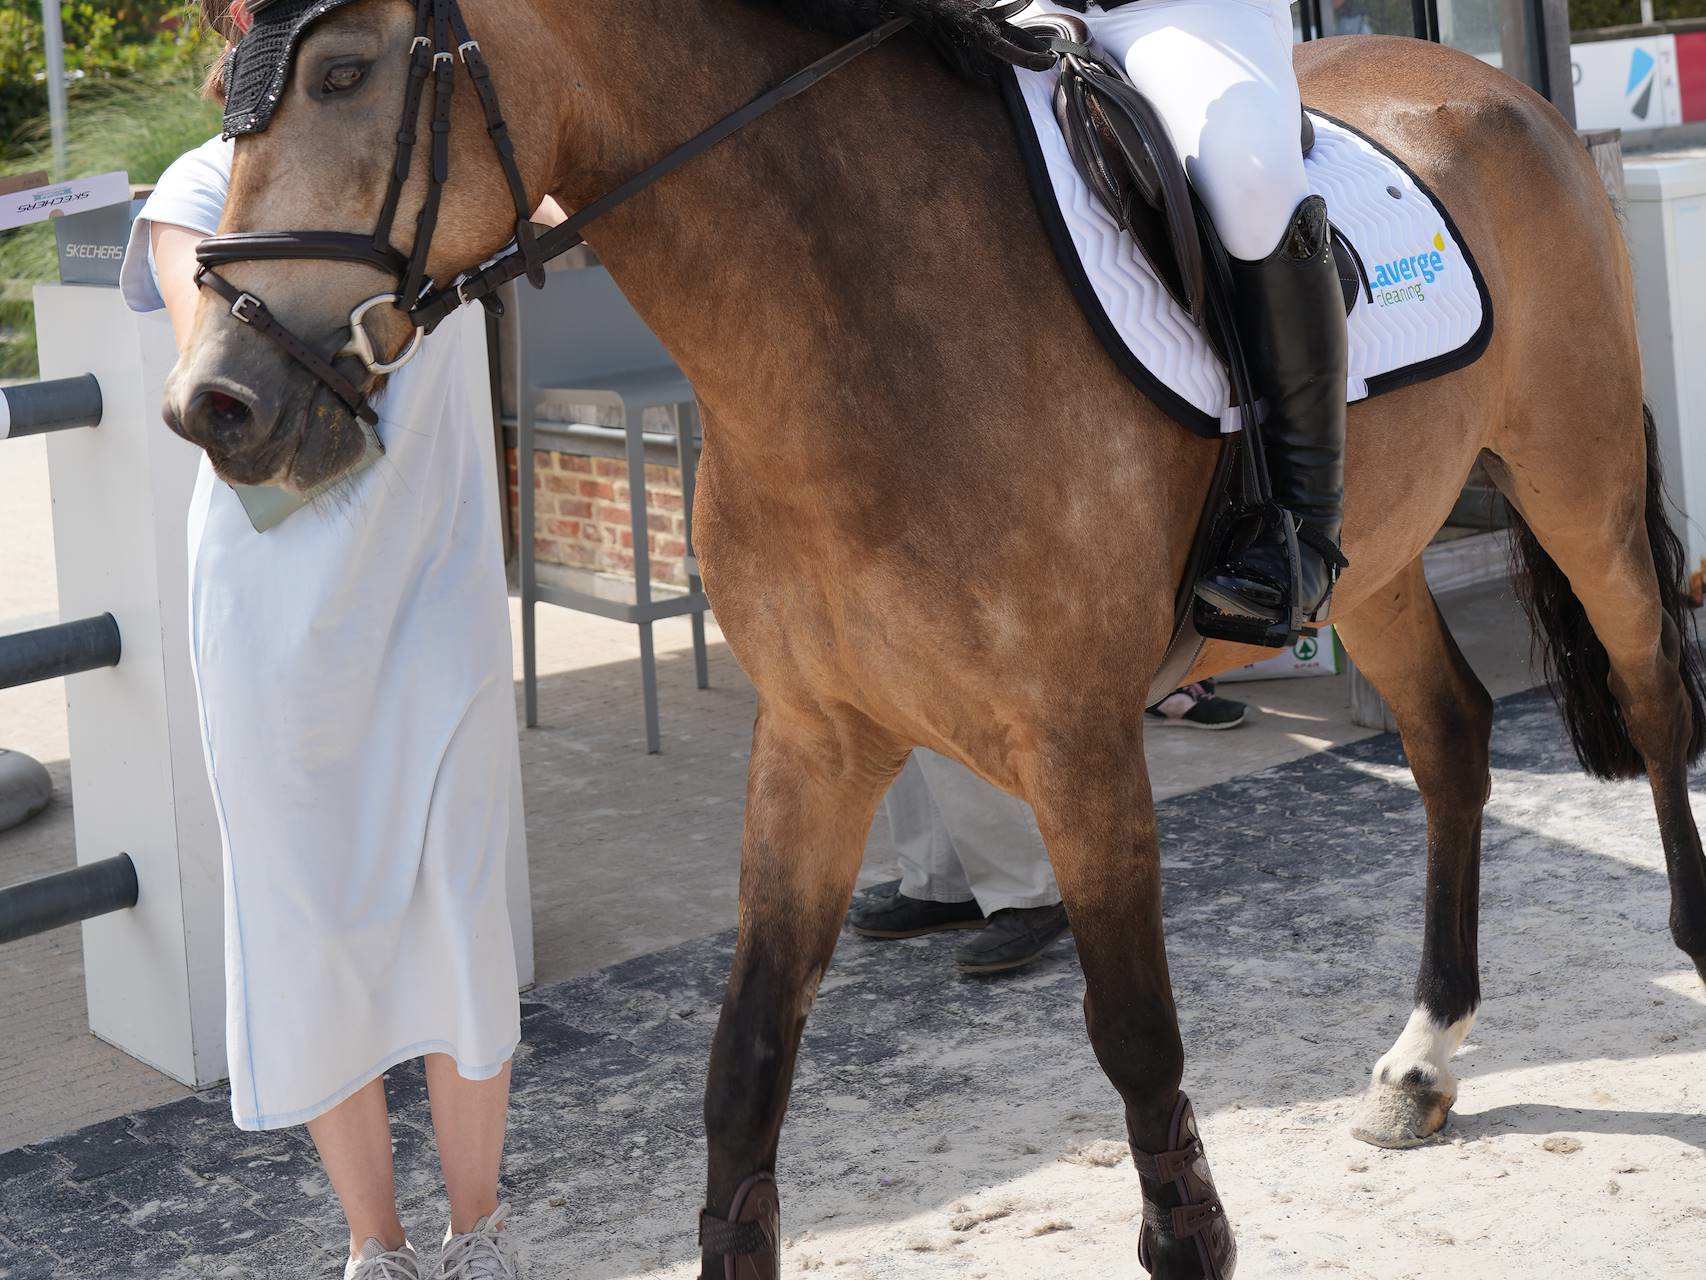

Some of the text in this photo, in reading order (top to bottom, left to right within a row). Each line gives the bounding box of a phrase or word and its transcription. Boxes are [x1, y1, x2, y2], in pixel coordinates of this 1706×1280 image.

[18, 191, 90, 212] SKECHERS
[66, 243, 123, 259] SKECHERS
[1370, 251, 1444, 288] averge
[1377, 283, 1424, 308] cleaning
